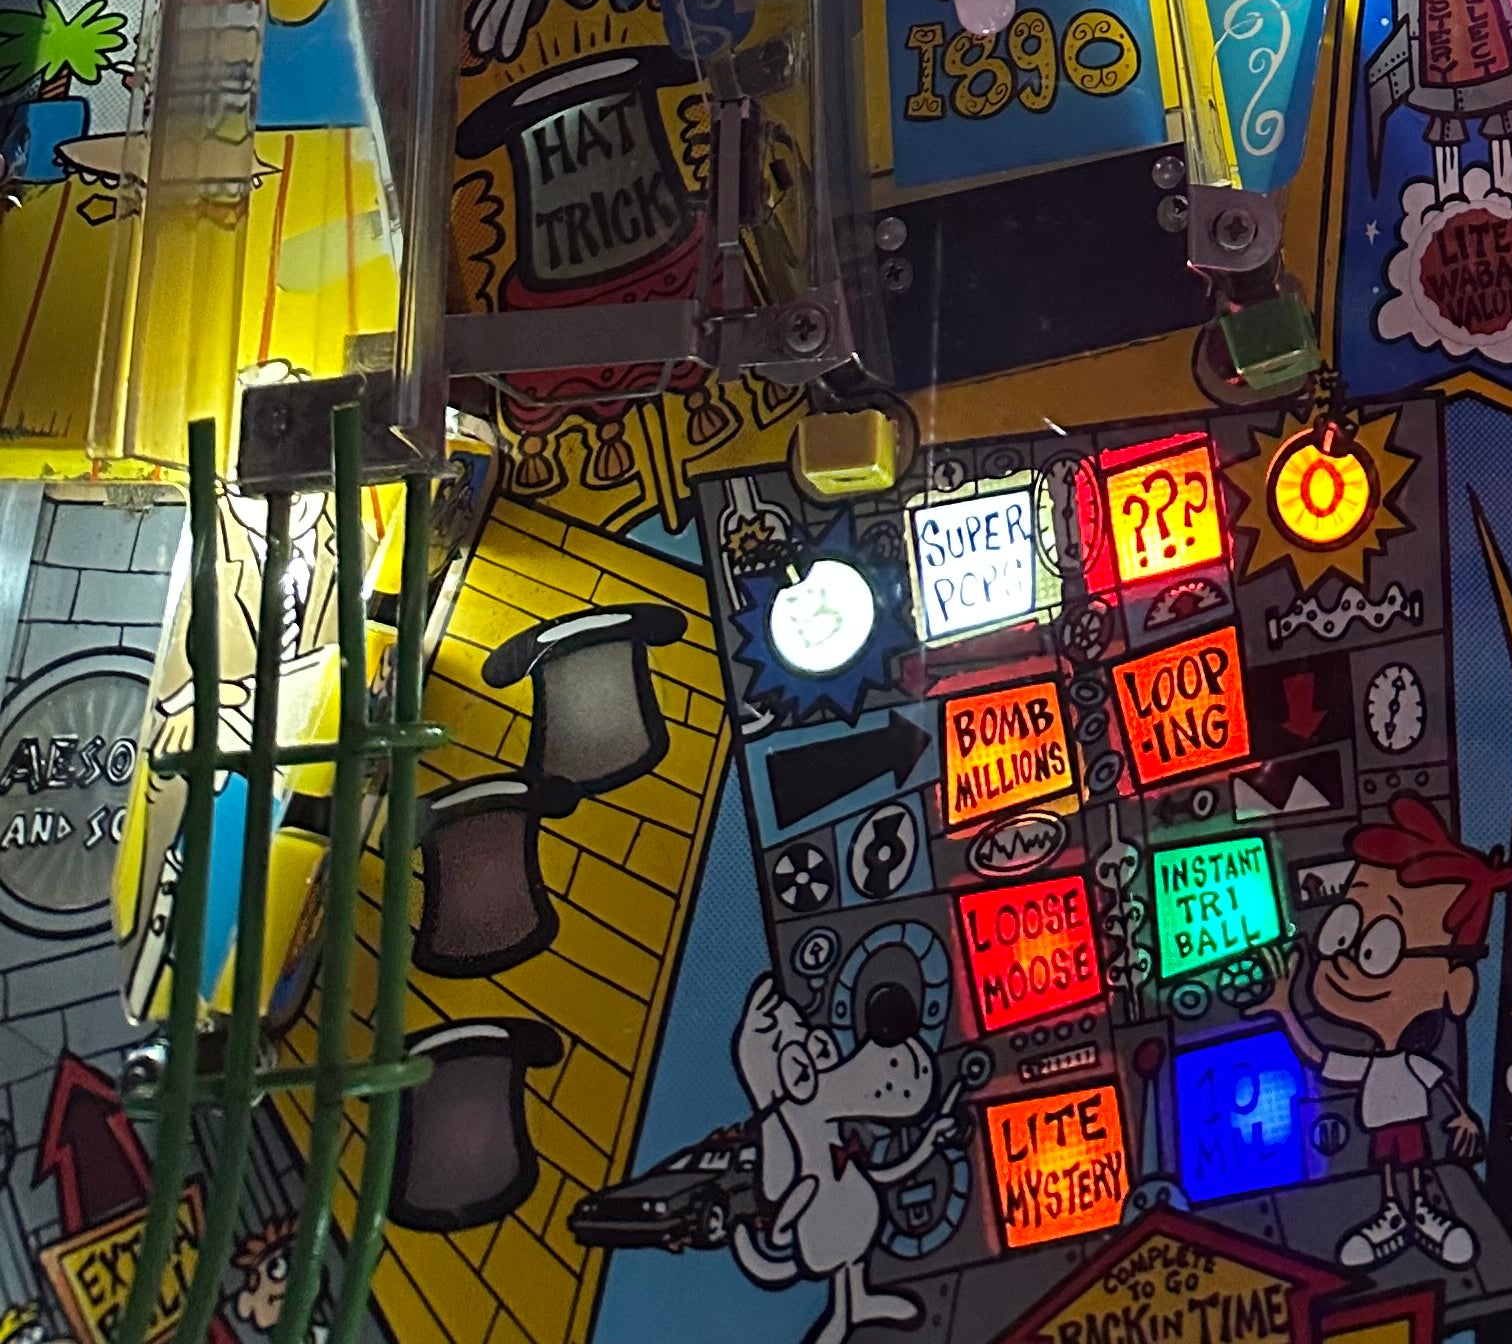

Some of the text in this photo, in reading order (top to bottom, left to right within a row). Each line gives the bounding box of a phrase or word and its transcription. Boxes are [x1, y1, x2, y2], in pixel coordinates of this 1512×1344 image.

[905, 9, 1141, 121] 1890
[532, 95, 638, 186] HAT
[535, 172, 680, 272] TRICK
[1435, 219, 1512, 267] LITE
[919, 502, 1034, 567] SUPER
[1124, 646, 1229, 719] LOOP
[953, 698, 1055, 757] BOMB
[0, 734, 138, 794] AESO
[955, 742, 1066, 812] MILLIONS
[0, 808, 77, 852] AND
[1161, 845, 1262, 895] INSTANT
[966, 889, 1087, 955] LOOSE
[1176, 885, 1240, 925] TRI
[1175, 915, 1262, 959] BALL
[982, 943, 1093, 1015] MOOSE
[1001, 1092, 1108, 1163] LITE
[1003, 1150, 1122, 1229] MYSTERY
[1102, 1243, 1217, 1295] COMPLETE
[1128, 1268, 1199, 1303] TO GO
[1149, 1309, 1184, 1341] IN
[1190, 1284, 1289, 1344] TIME
